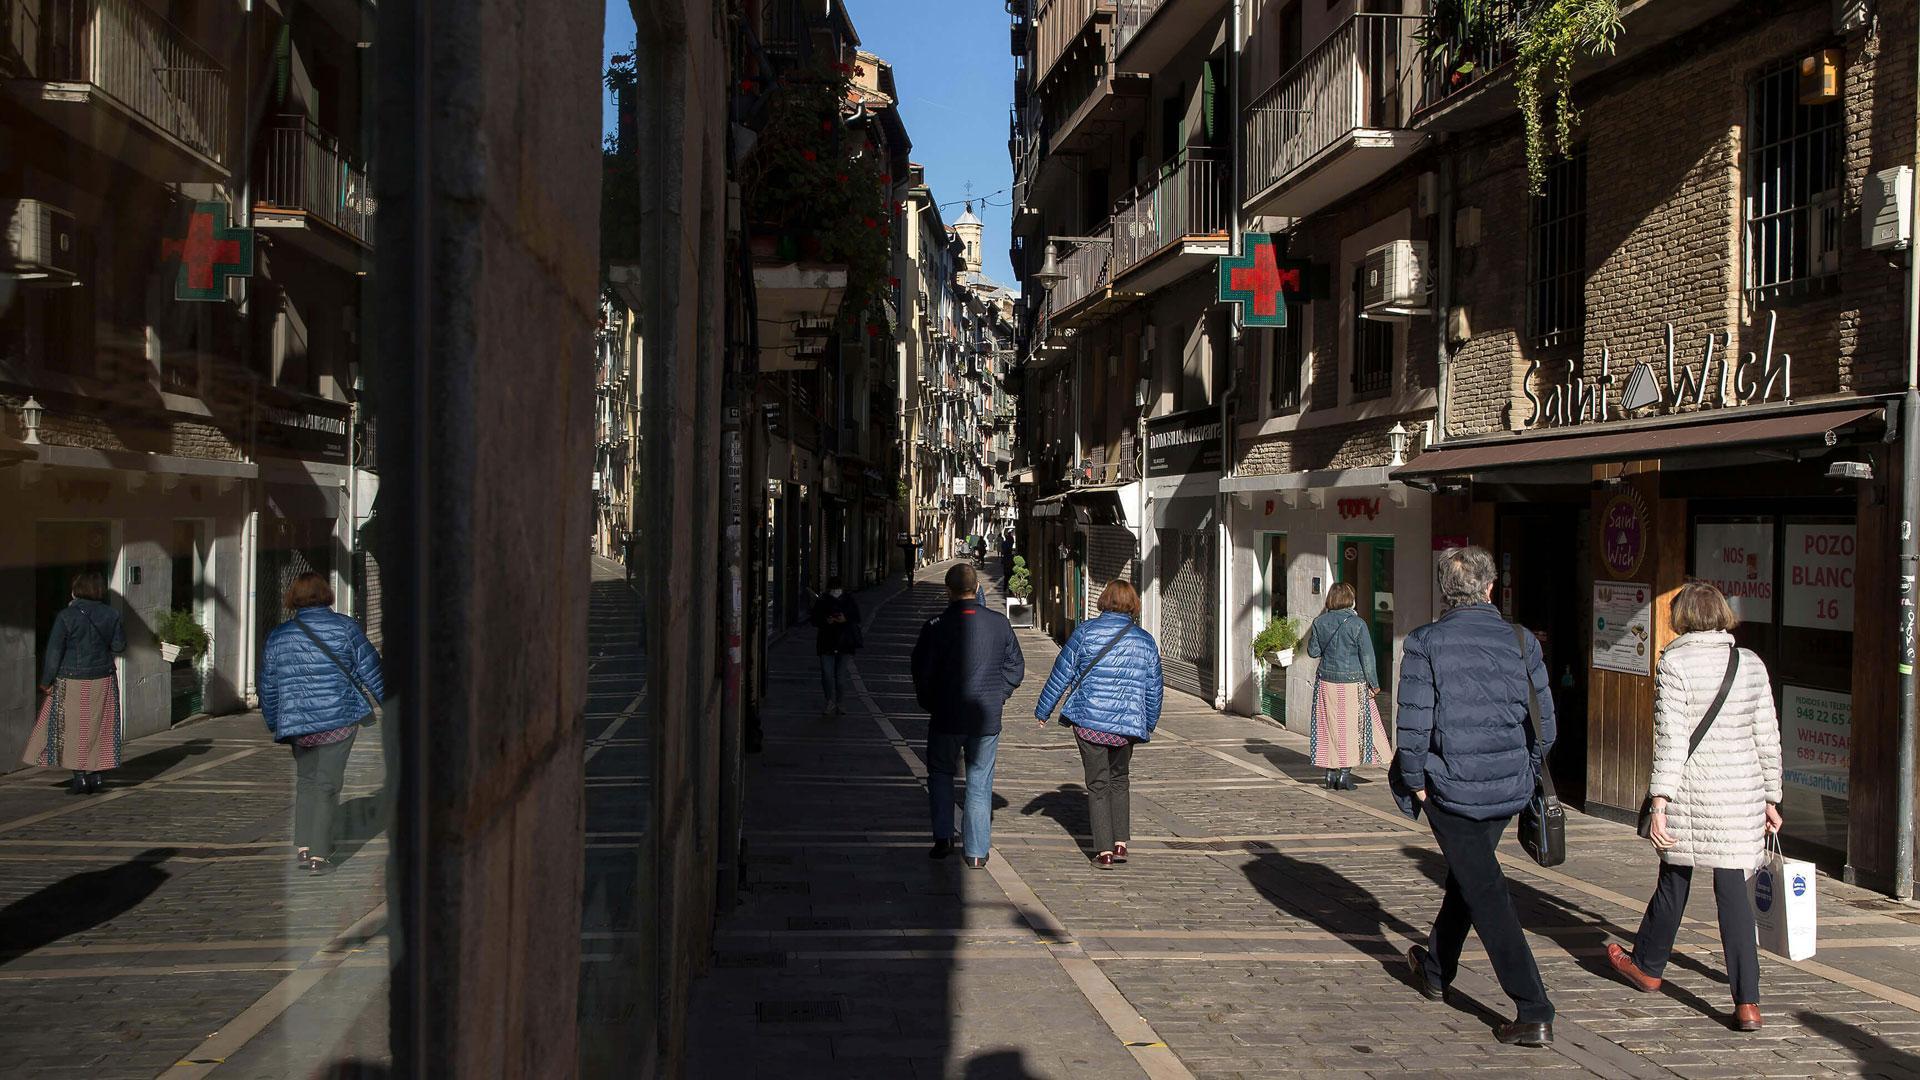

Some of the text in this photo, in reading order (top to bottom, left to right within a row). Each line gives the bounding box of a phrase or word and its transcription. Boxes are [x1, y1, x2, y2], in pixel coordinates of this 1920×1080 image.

[1524, 310, 1791, 427] Saint Wich
[1609, 507, 1638, 530] Saint
[1607, 541, 1635, 569] Wich
[1723, 547, 1744, 564] NOS
[1804, 534, 1855, 556] POZO
[1792, 566, 1856, 588] BLANC
[1817, 598, 1839, 620] 16
[1796, 706, 1815, 721] 948
[1817, 710, 1829, 723] 22
[1831, 713, 1845, 726] 65
[1797, 746, 1815, 761] 689
[1817, 751, 1837, 766] 473
